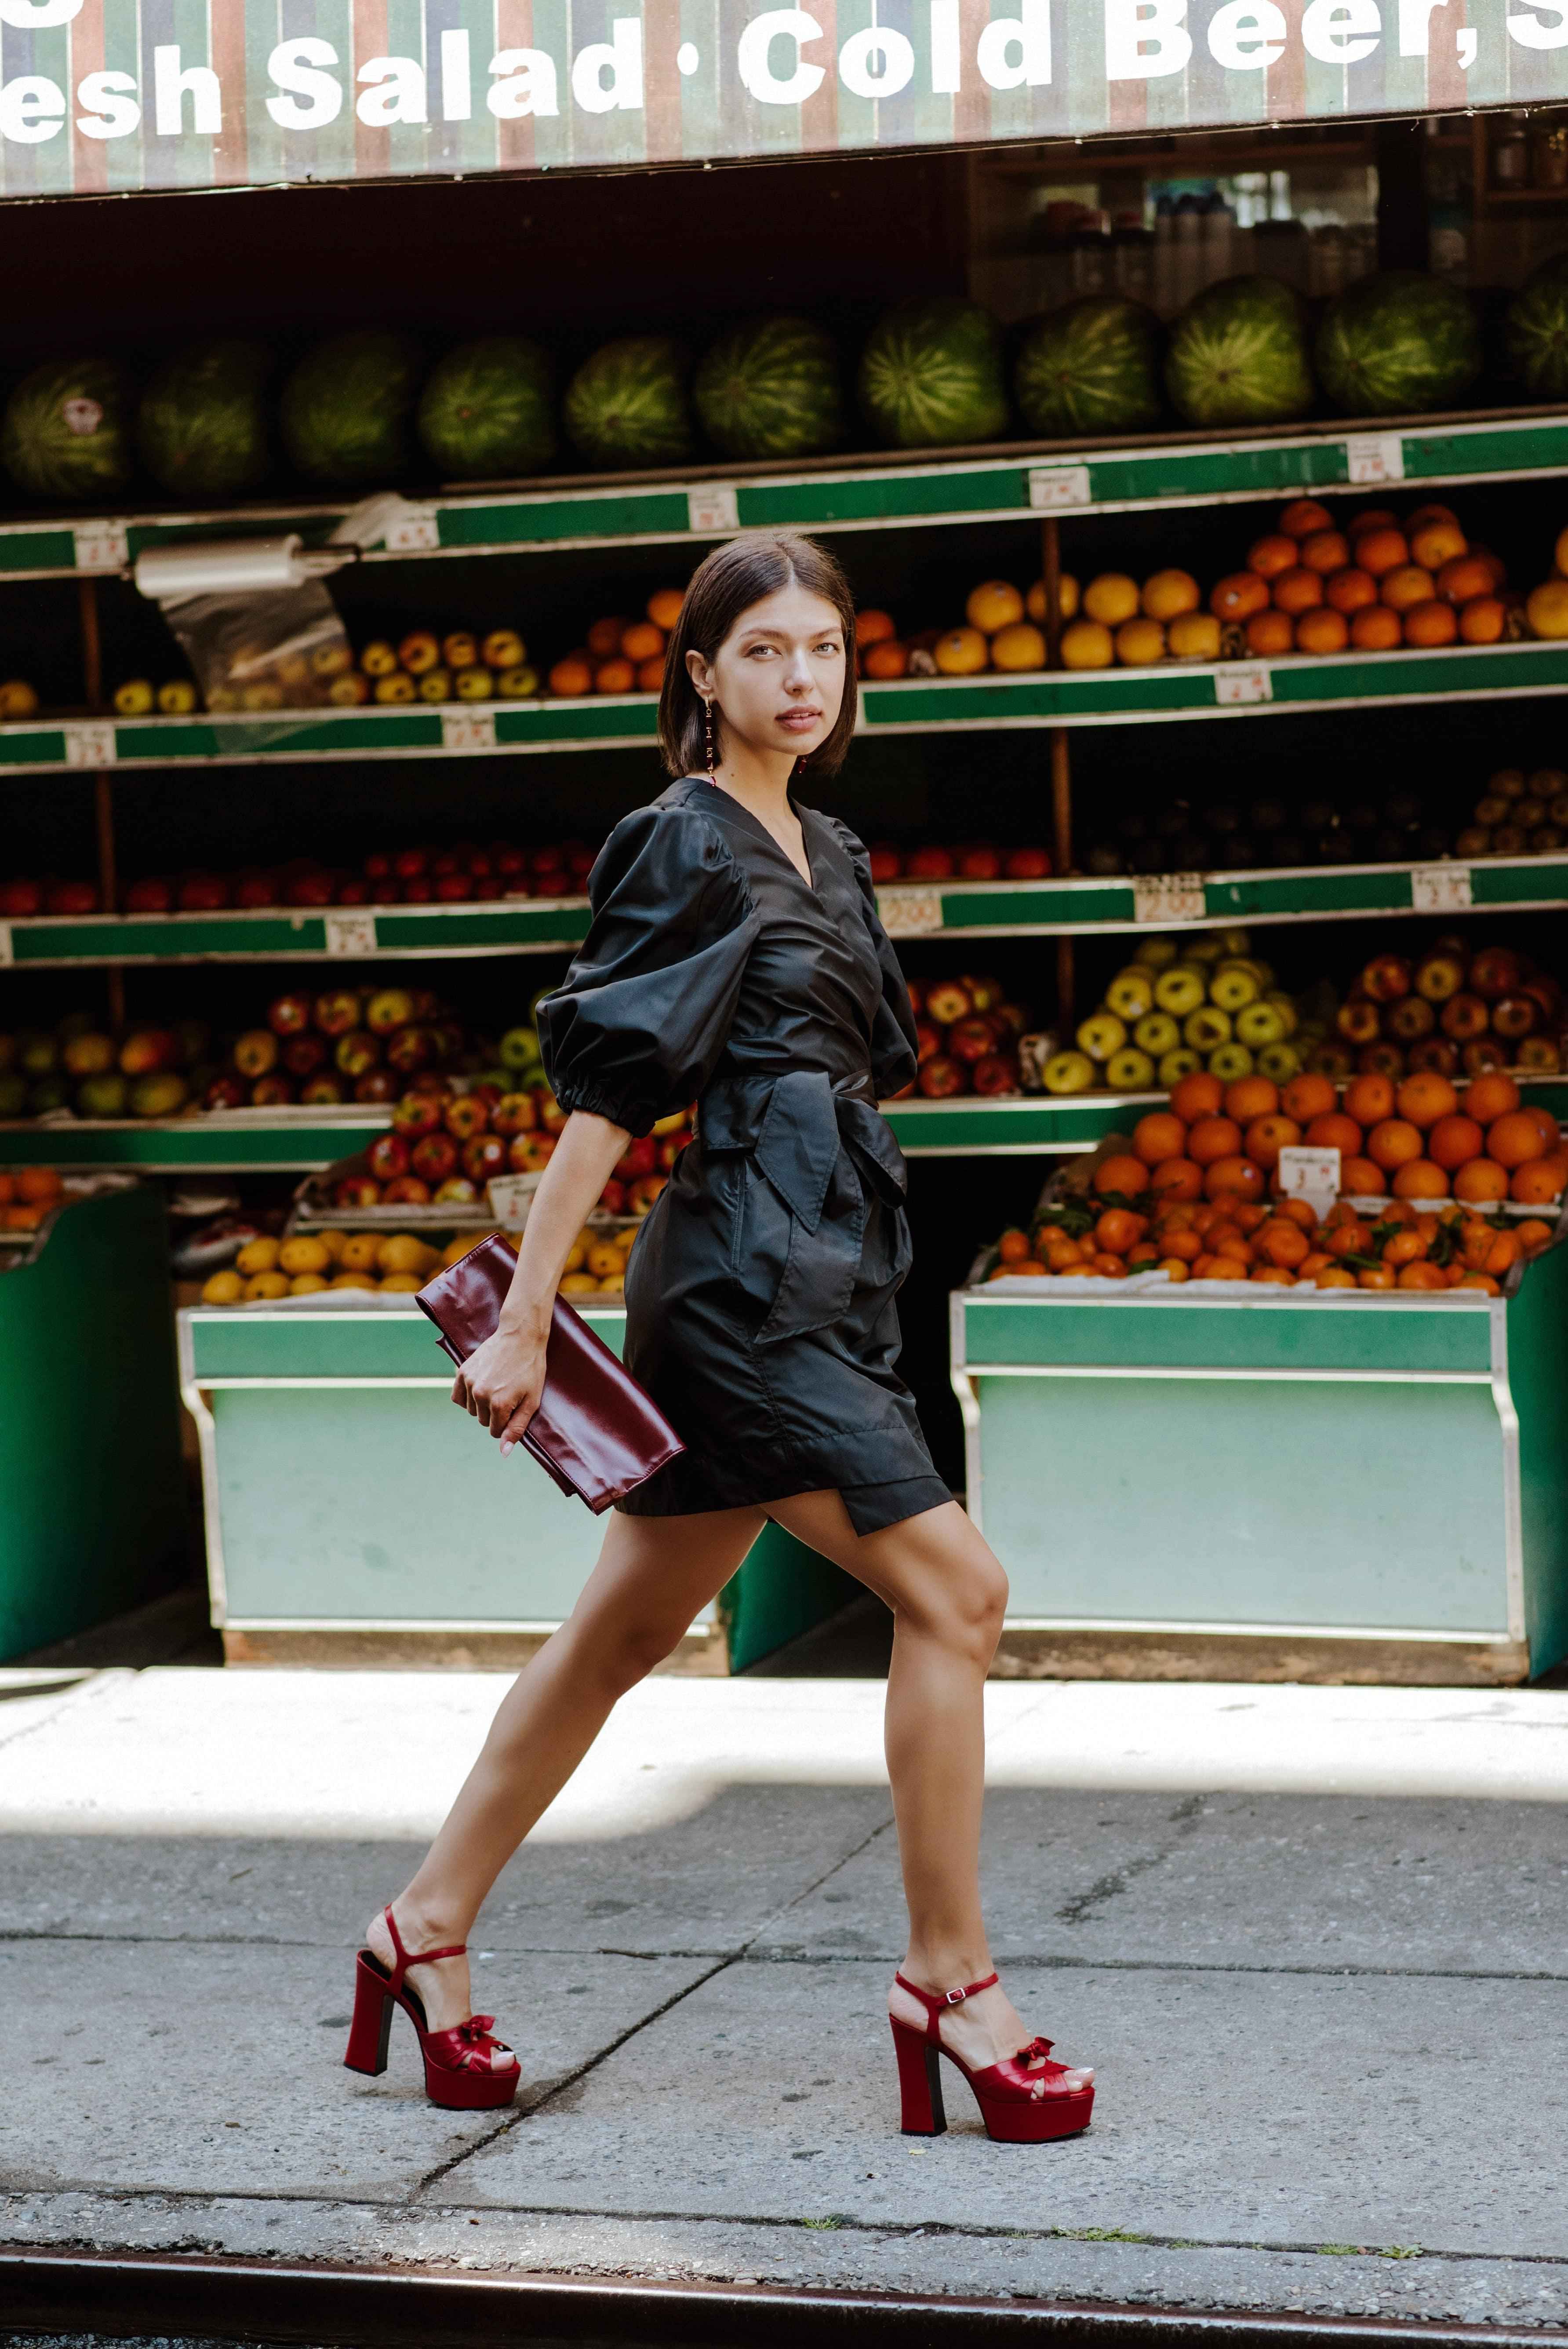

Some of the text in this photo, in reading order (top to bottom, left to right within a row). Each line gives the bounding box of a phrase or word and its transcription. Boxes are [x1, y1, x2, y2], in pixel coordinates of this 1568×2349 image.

[0, 45, 222, 143] esh
[266, 18, 644, 130] Salad
[739, 0, 1052, 105] Cold
[1105, 0, 1477, 80] Beer,
